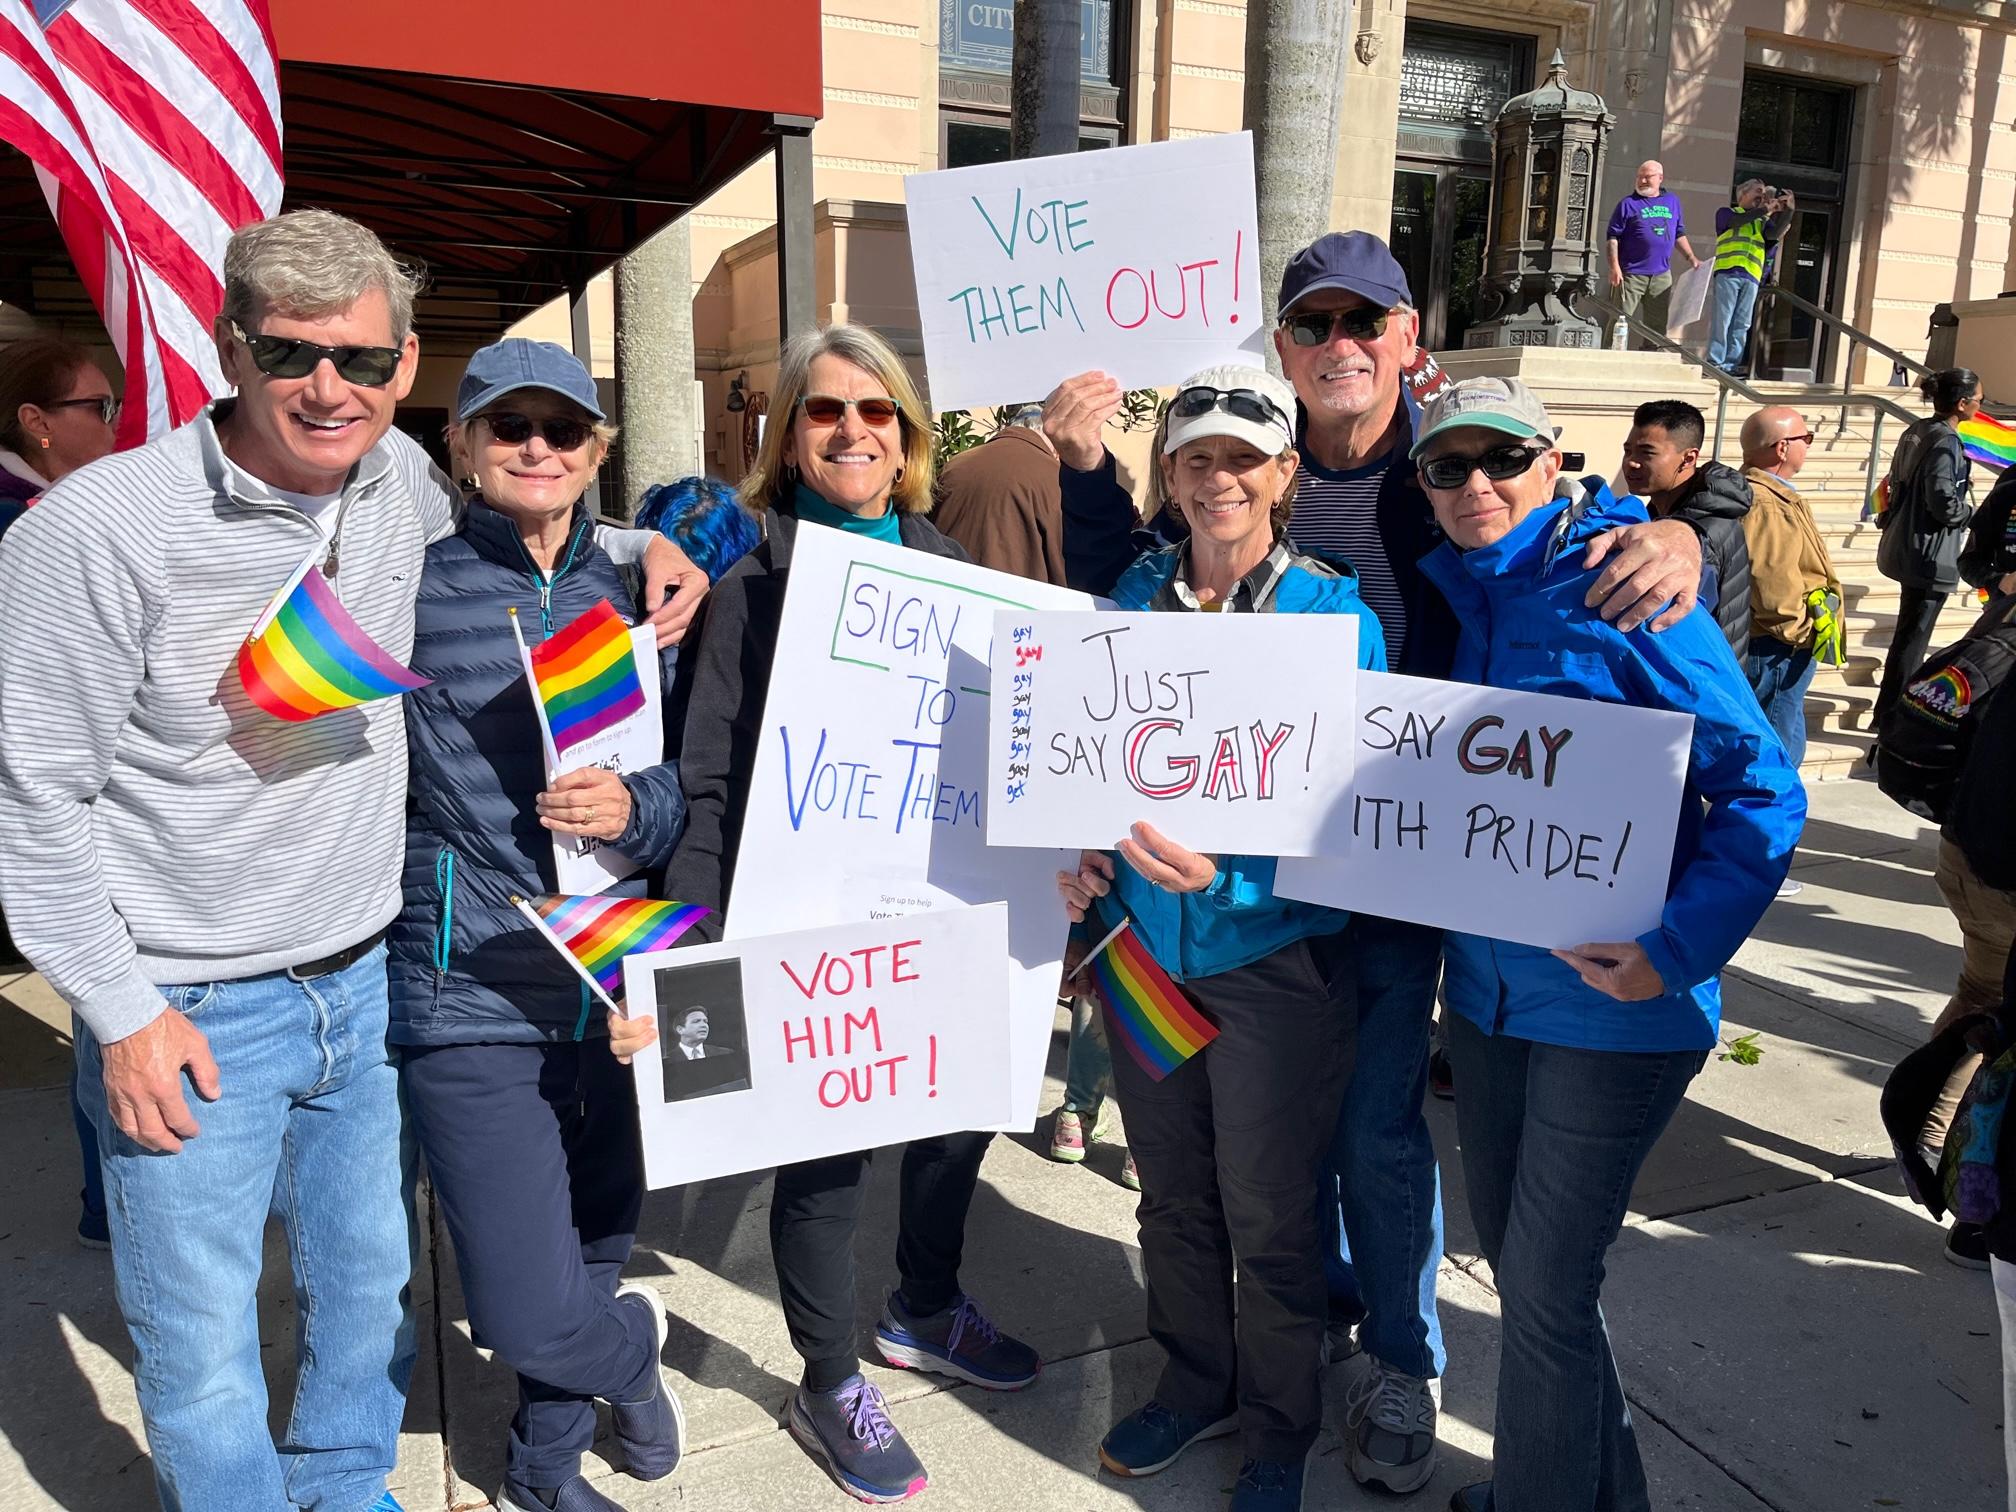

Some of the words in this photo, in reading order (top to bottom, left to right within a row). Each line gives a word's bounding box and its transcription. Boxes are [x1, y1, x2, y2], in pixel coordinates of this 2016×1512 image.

[970, 187, 1095, 261] VOTE
[947, 276, 1086, 343] THEM
[1105, 229, 1242, 330] OUT!
[846, 583, 961, 660] SIGN
[1012, 625, 1033, 643] gay
[1013, 671, 1033, 692] gay
[1015, 644, 1043, 667] gay
[1081, 626, 1210, 722] JUST
[906, 675, 957, 730] TO
[1011, 692, 1032, 707] gay
[1011, 706, 1032, 724] gay
[1008, 740, 1032, 760] gay
[1012, 725, 1031, 740] gay
[1048, 732, 1107, 782] SAY
[1361, 705, 1446, 760] SAY
[1457, 714, 1574, 788] GAY
[779, 726, 882, 832] VOTE
[892, 739, 980, 834] THEM
[1007, 762, 1030, 780] gay
[1353, 795, 1429, 850] ITH
[1464, 803, 1632, 888] PRIDE!
[880, 894, 896, 904] Sign
[896, 897, 906, 905] up
[907, 897, 916, 905] to
[916, 898, 932, 908] help
[780, 939, 922, 1000] VOTE
[783, 1006, 882, 1064] HIM
